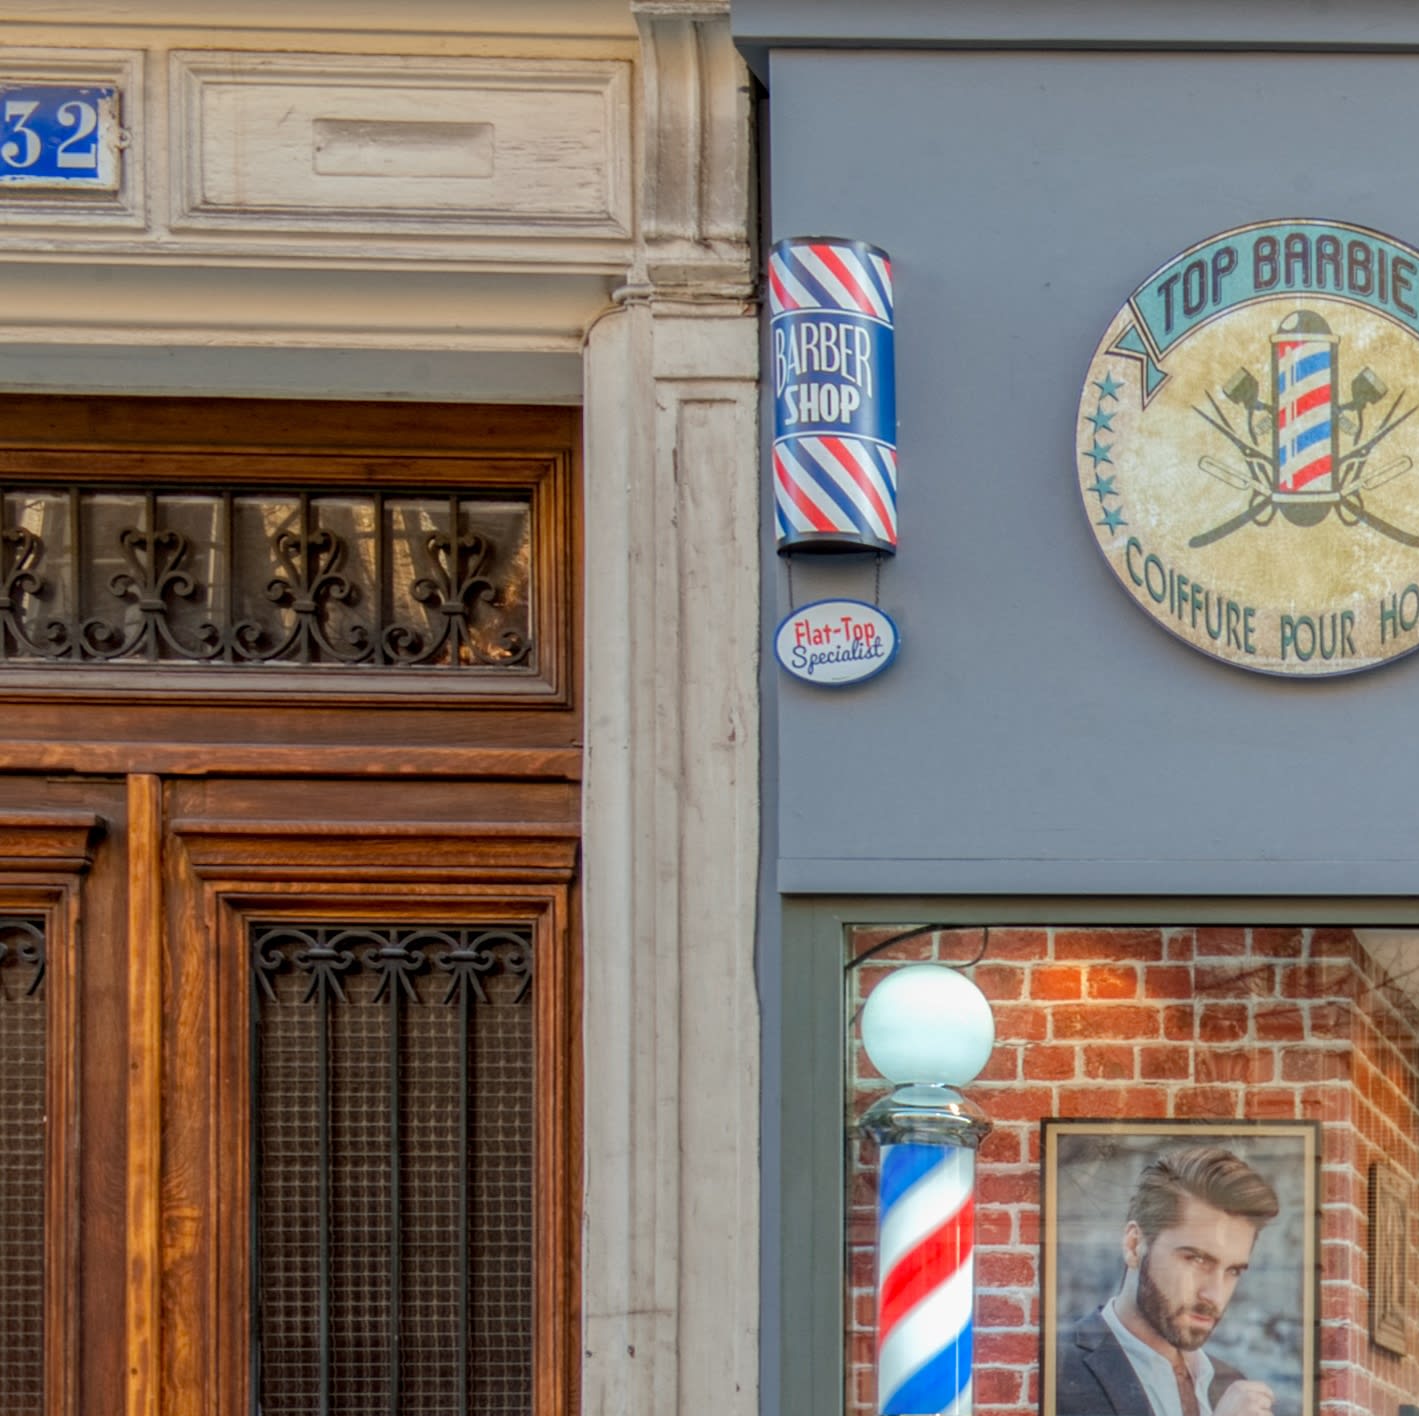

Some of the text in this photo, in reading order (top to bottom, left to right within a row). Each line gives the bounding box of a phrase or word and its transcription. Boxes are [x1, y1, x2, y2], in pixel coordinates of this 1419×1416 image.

[1, 100, 97, 168] 32
[1157, 247, 1238, 334] TOP
[775, 321, 873, 399] BARBER
[785, 382, 860, 426] SHOP
[794, 616, 876, 647] Flat-Top
[1125, 536, 1257, 655] COIFFURE
[1280, 609, 1356, 661] POUR
[791, 637, 885, 675] Specialist
